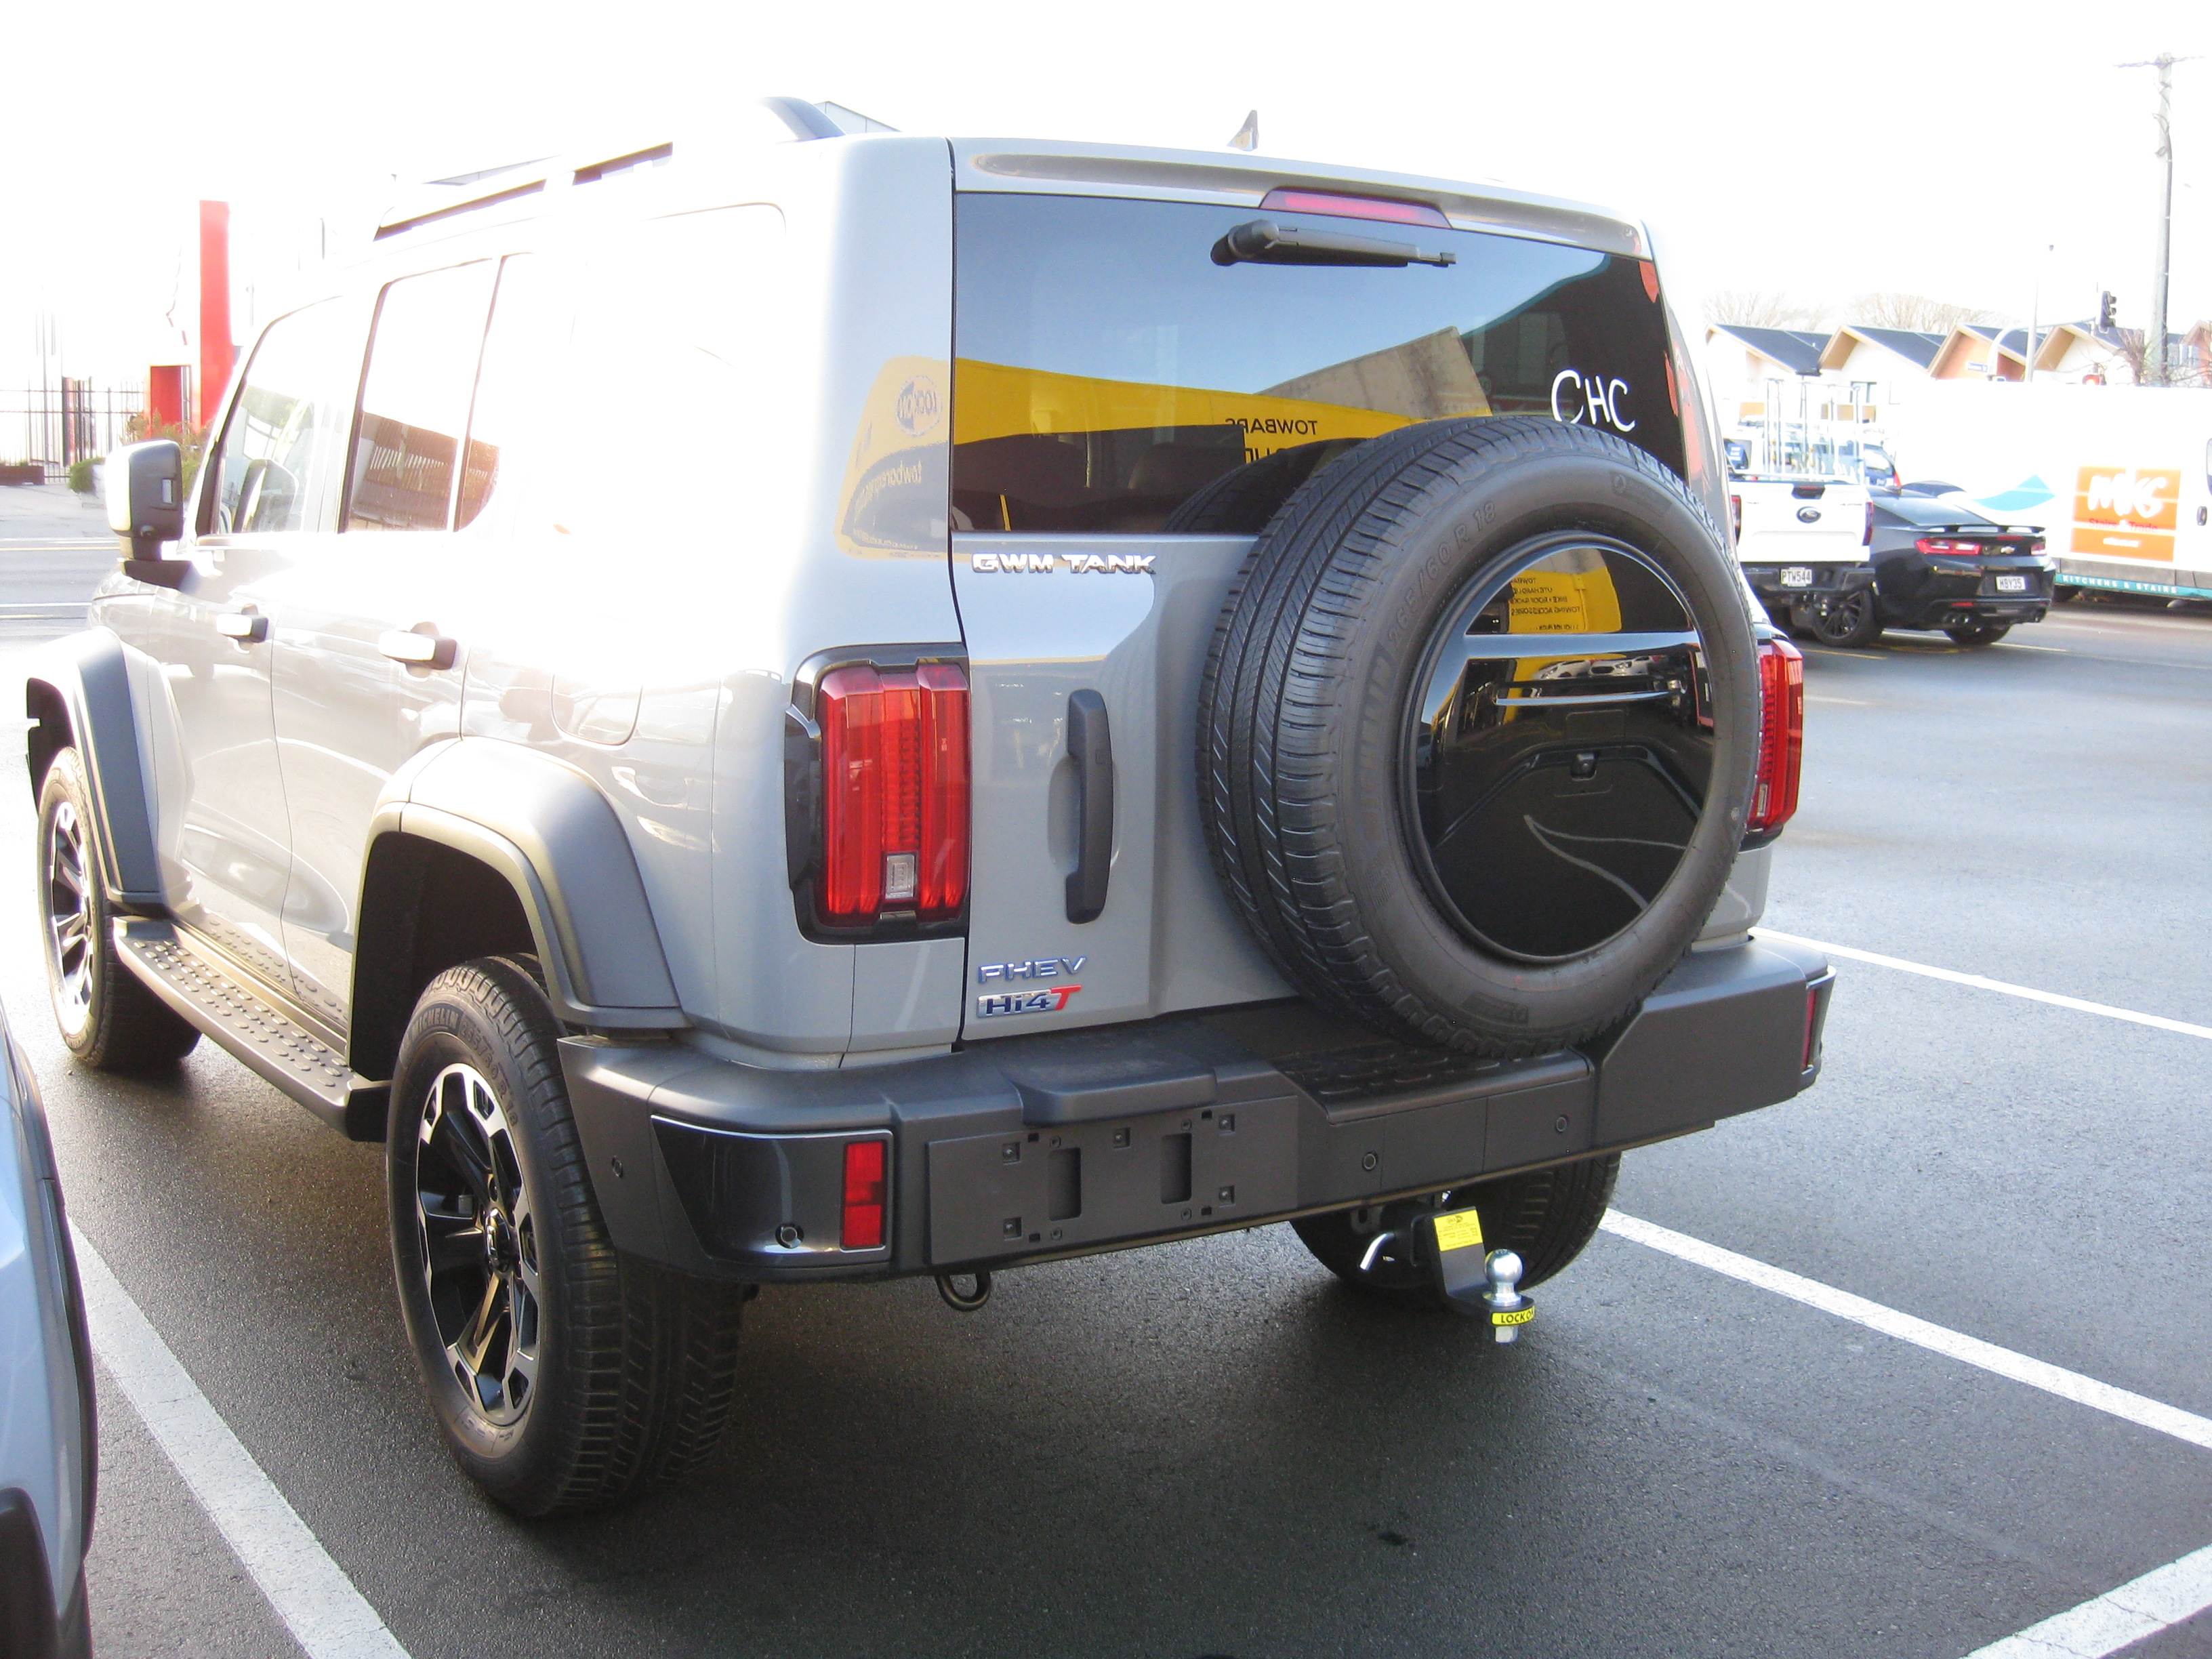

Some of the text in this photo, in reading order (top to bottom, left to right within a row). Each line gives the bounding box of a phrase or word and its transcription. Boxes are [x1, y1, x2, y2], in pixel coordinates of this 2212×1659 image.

[1551, 369, 1635, 432] CHC
[972, 553, 1156, 575] GWM TANK
[1782, 571, 1811, 582] PTW544
[2062, 575, 2118, 588] KITCHENS
[2136, 583, 2178, 594] STAIRS
[978, 956, 1088, 984] PHEV
[1501, 1313, 1525, 1323] LOCK
